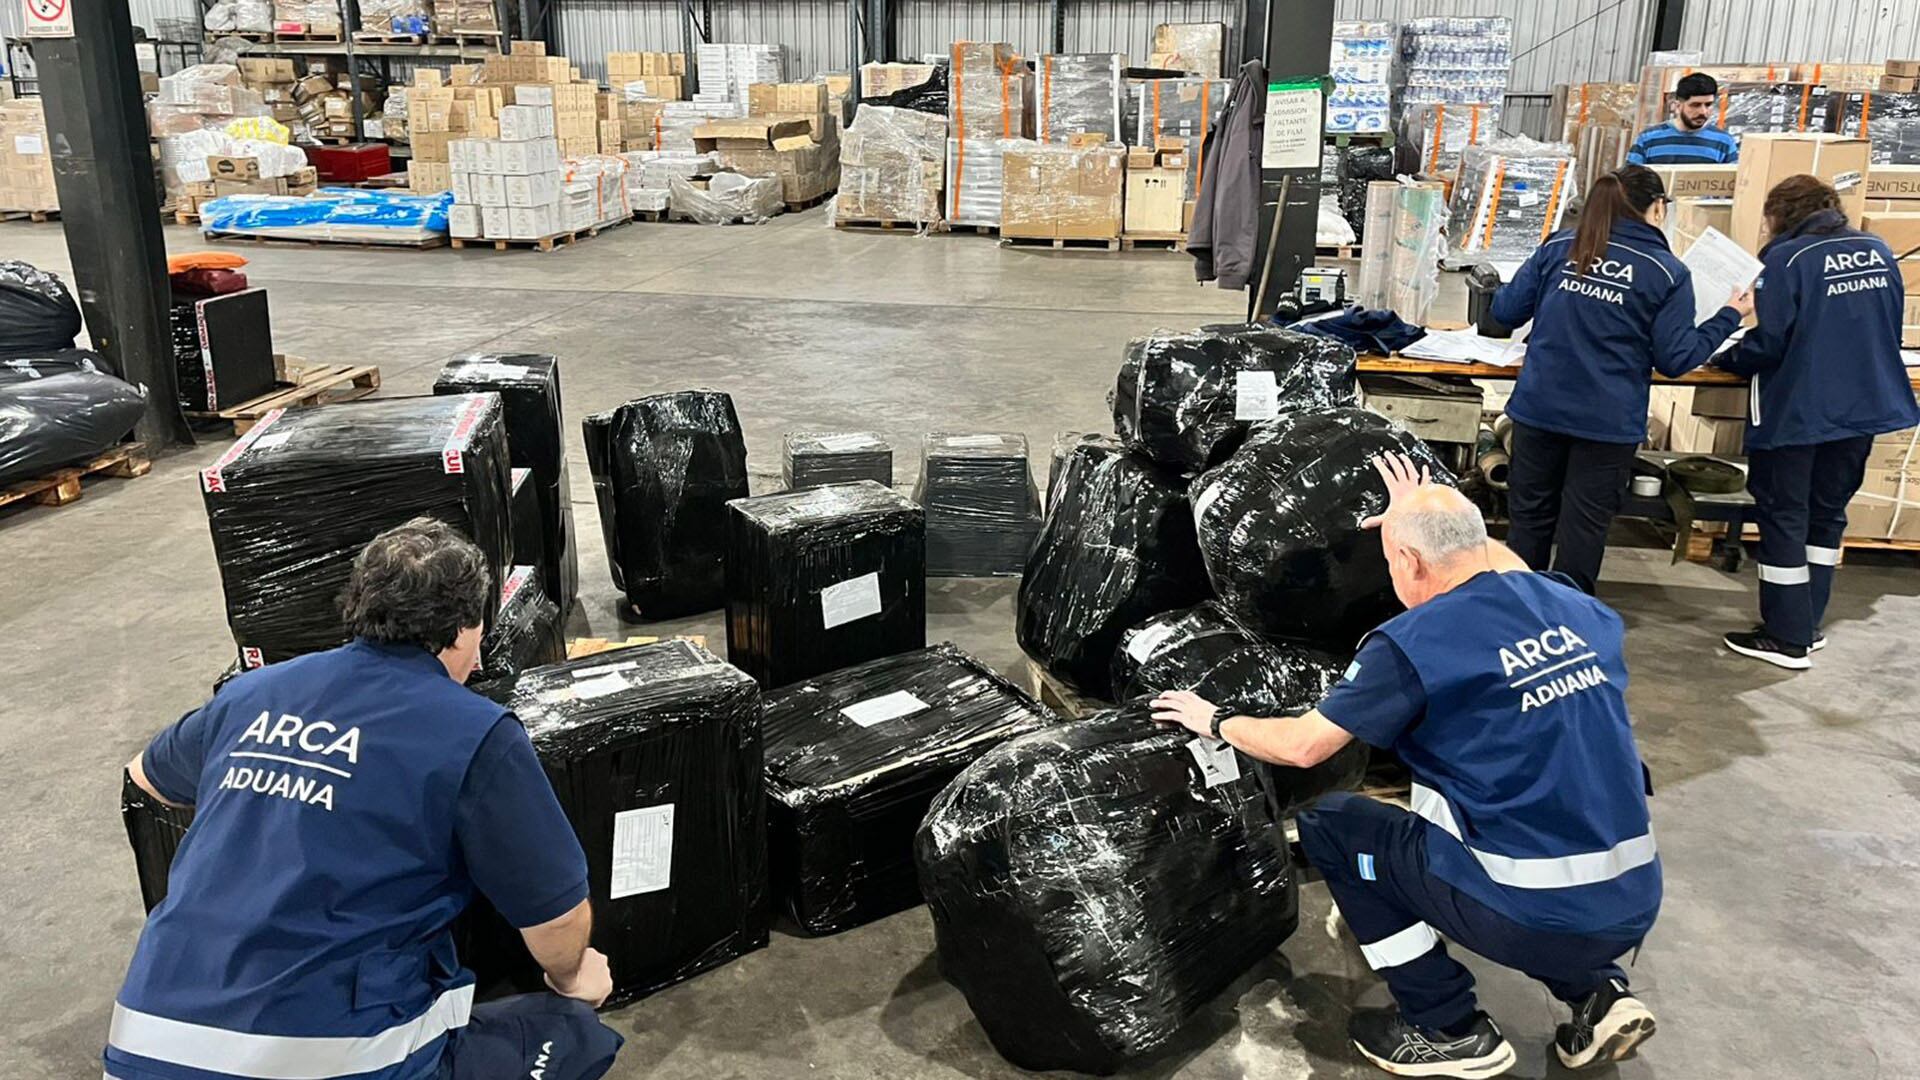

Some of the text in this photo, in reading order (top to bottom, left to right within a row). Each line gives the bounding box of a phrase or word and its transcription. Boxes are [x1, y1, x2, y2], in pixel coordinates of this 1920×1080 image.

[1823, 248, 1886, 273] ARCA
[1558, 278, 1624, 305] ADUANA
[1827, 276, 1889, 297] ADUANA
[1498, 625, 1588, 677] ARCA
[1521, 664, 1609, 713] ADUANA
[238, 710, 360, 764] ARCA
[219, 766, 334, 811] ADUANA
